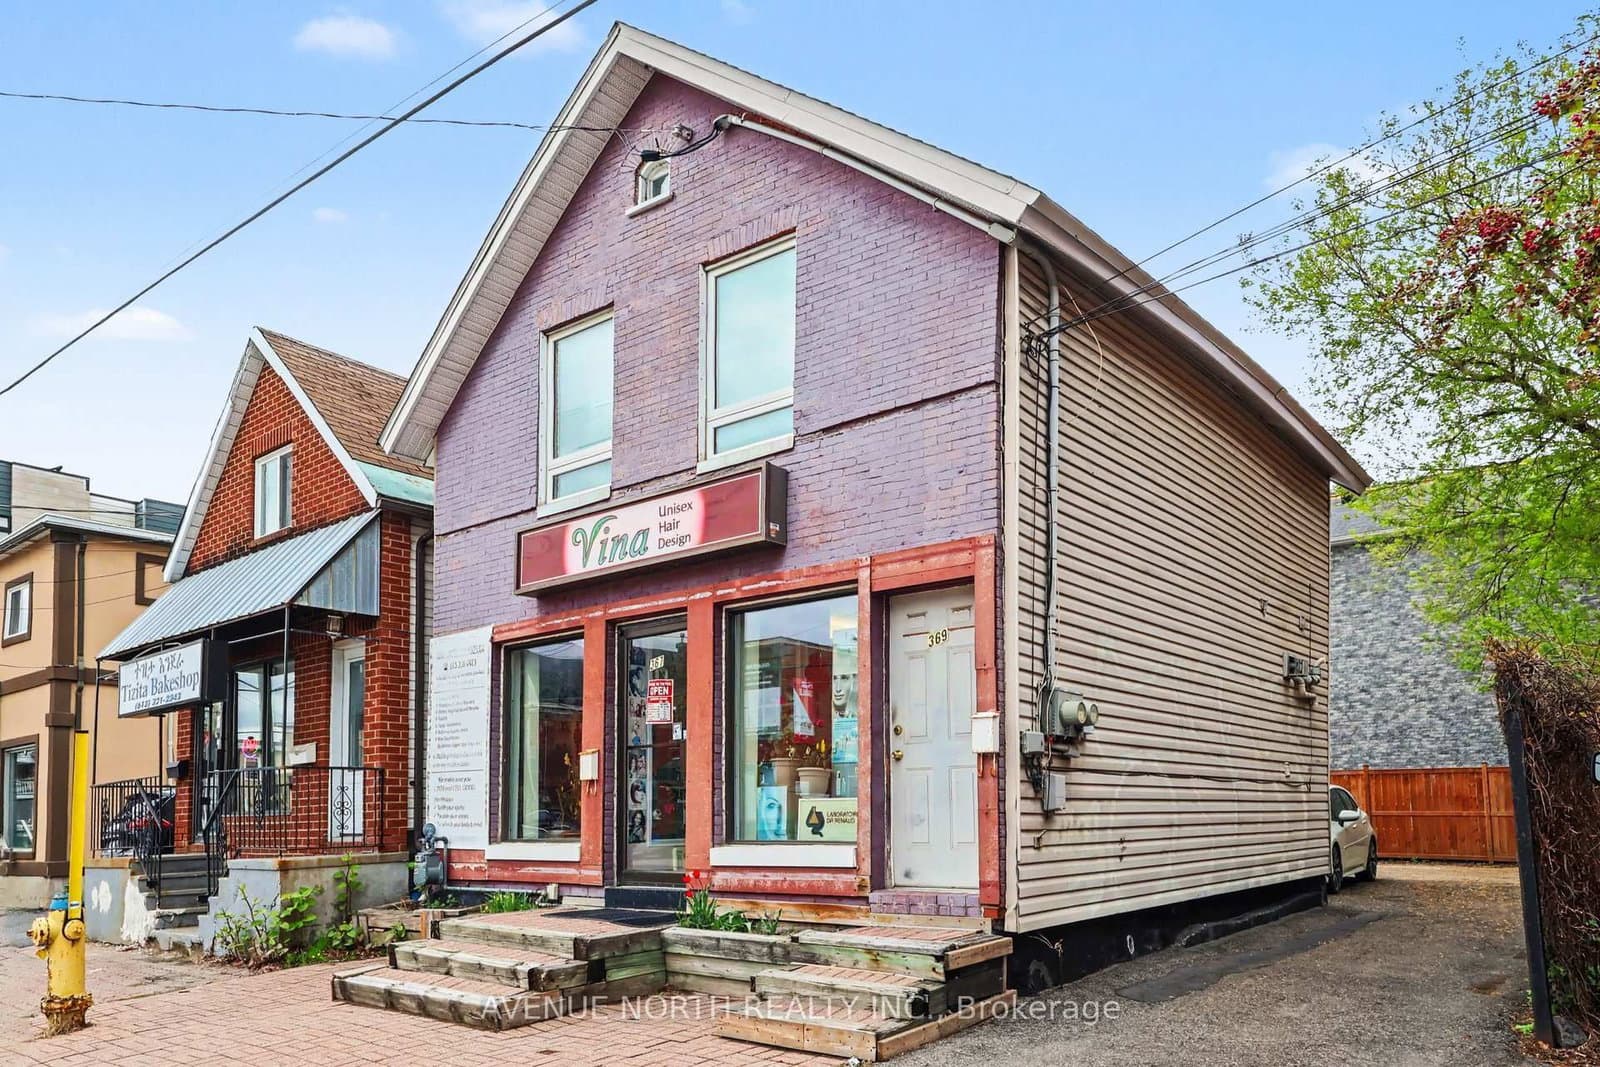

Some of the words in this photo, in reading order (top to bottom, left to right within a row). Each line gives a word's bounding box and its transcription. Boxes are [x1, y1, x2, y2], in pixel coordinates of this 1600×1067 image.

[658, 501, 693, 518] Unisex
[658, 519, 680, 534] Hair
[572, 515, 650, 568] Vina
[658, 534, 691, 550] Design
[929, 629, 947, 647] 369
[122, 681, 148, 702] Tizita
[151, 670, 199, 696] Bakeshop
[650, 686, 669, 696] OPEN
